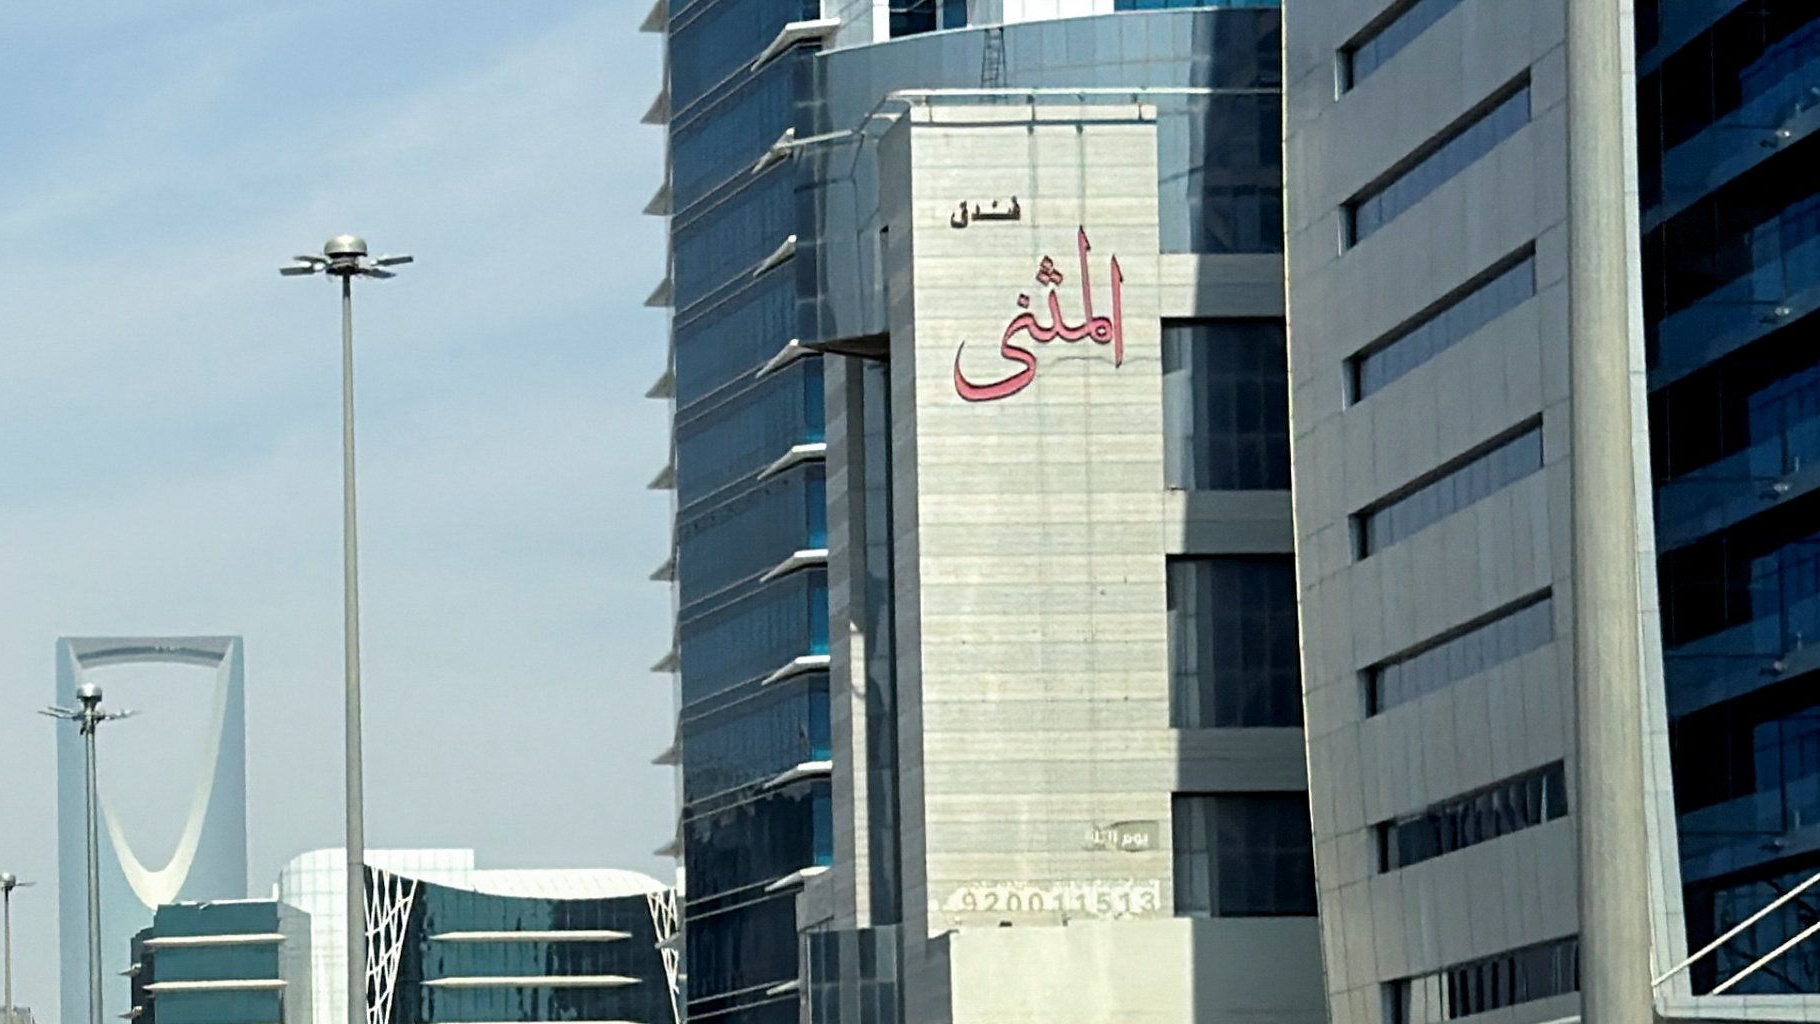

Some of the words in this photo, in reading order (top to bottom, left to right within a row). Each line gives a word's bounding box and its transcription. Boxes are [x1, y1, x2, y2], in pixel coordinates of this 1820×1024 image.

[950, 195, 1021, 229] فندق
[953, 225, 1124, 402] المثنى
[961, 890, 1156, 912] 920011513
